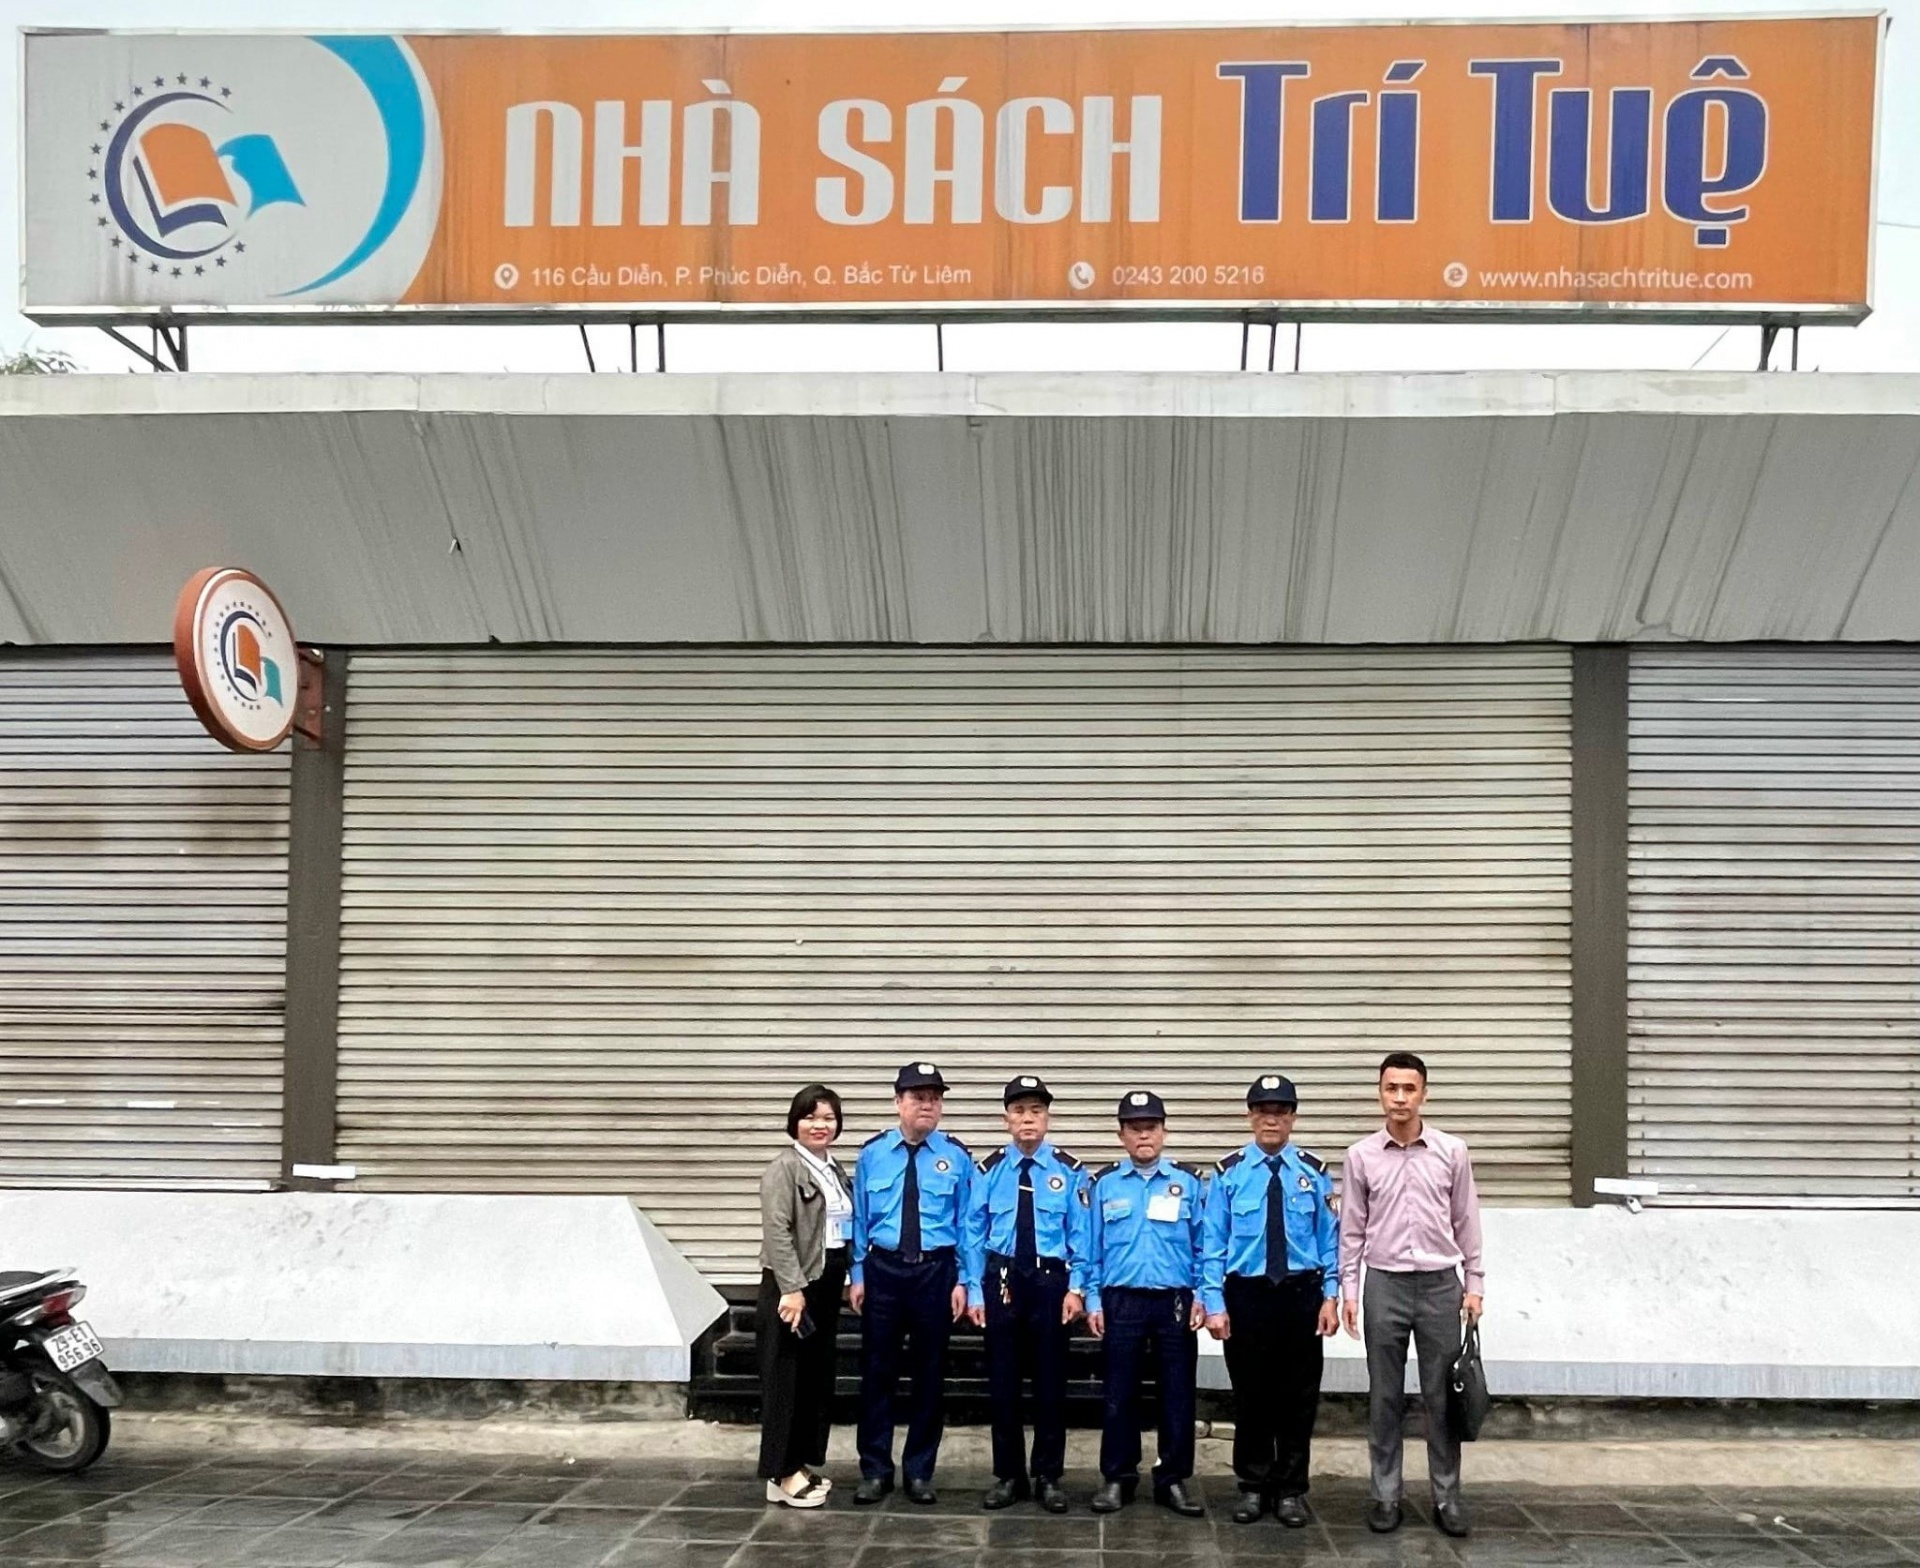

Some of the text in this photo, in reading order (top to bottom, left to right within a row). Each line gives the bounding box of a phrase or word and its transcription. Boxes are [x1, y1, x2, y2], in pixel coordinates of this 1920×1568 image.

[504, 54, 1770, 249] NHÀ SÁCH Trí Tuệ
[531, 267, 565, 287] 116
[675, 266, 692, 286] P.
[699, 264, 751, 285] Phúc
[814, 265, 837, 285] Q.
[844, 261, 883, 284] Bắc
[923, 264, 971, 284] Liêm
[1112, 265, 1266, 286] 0243 200 5216
[1479, 265, 1753, 289] www.nhasachtritue.com
